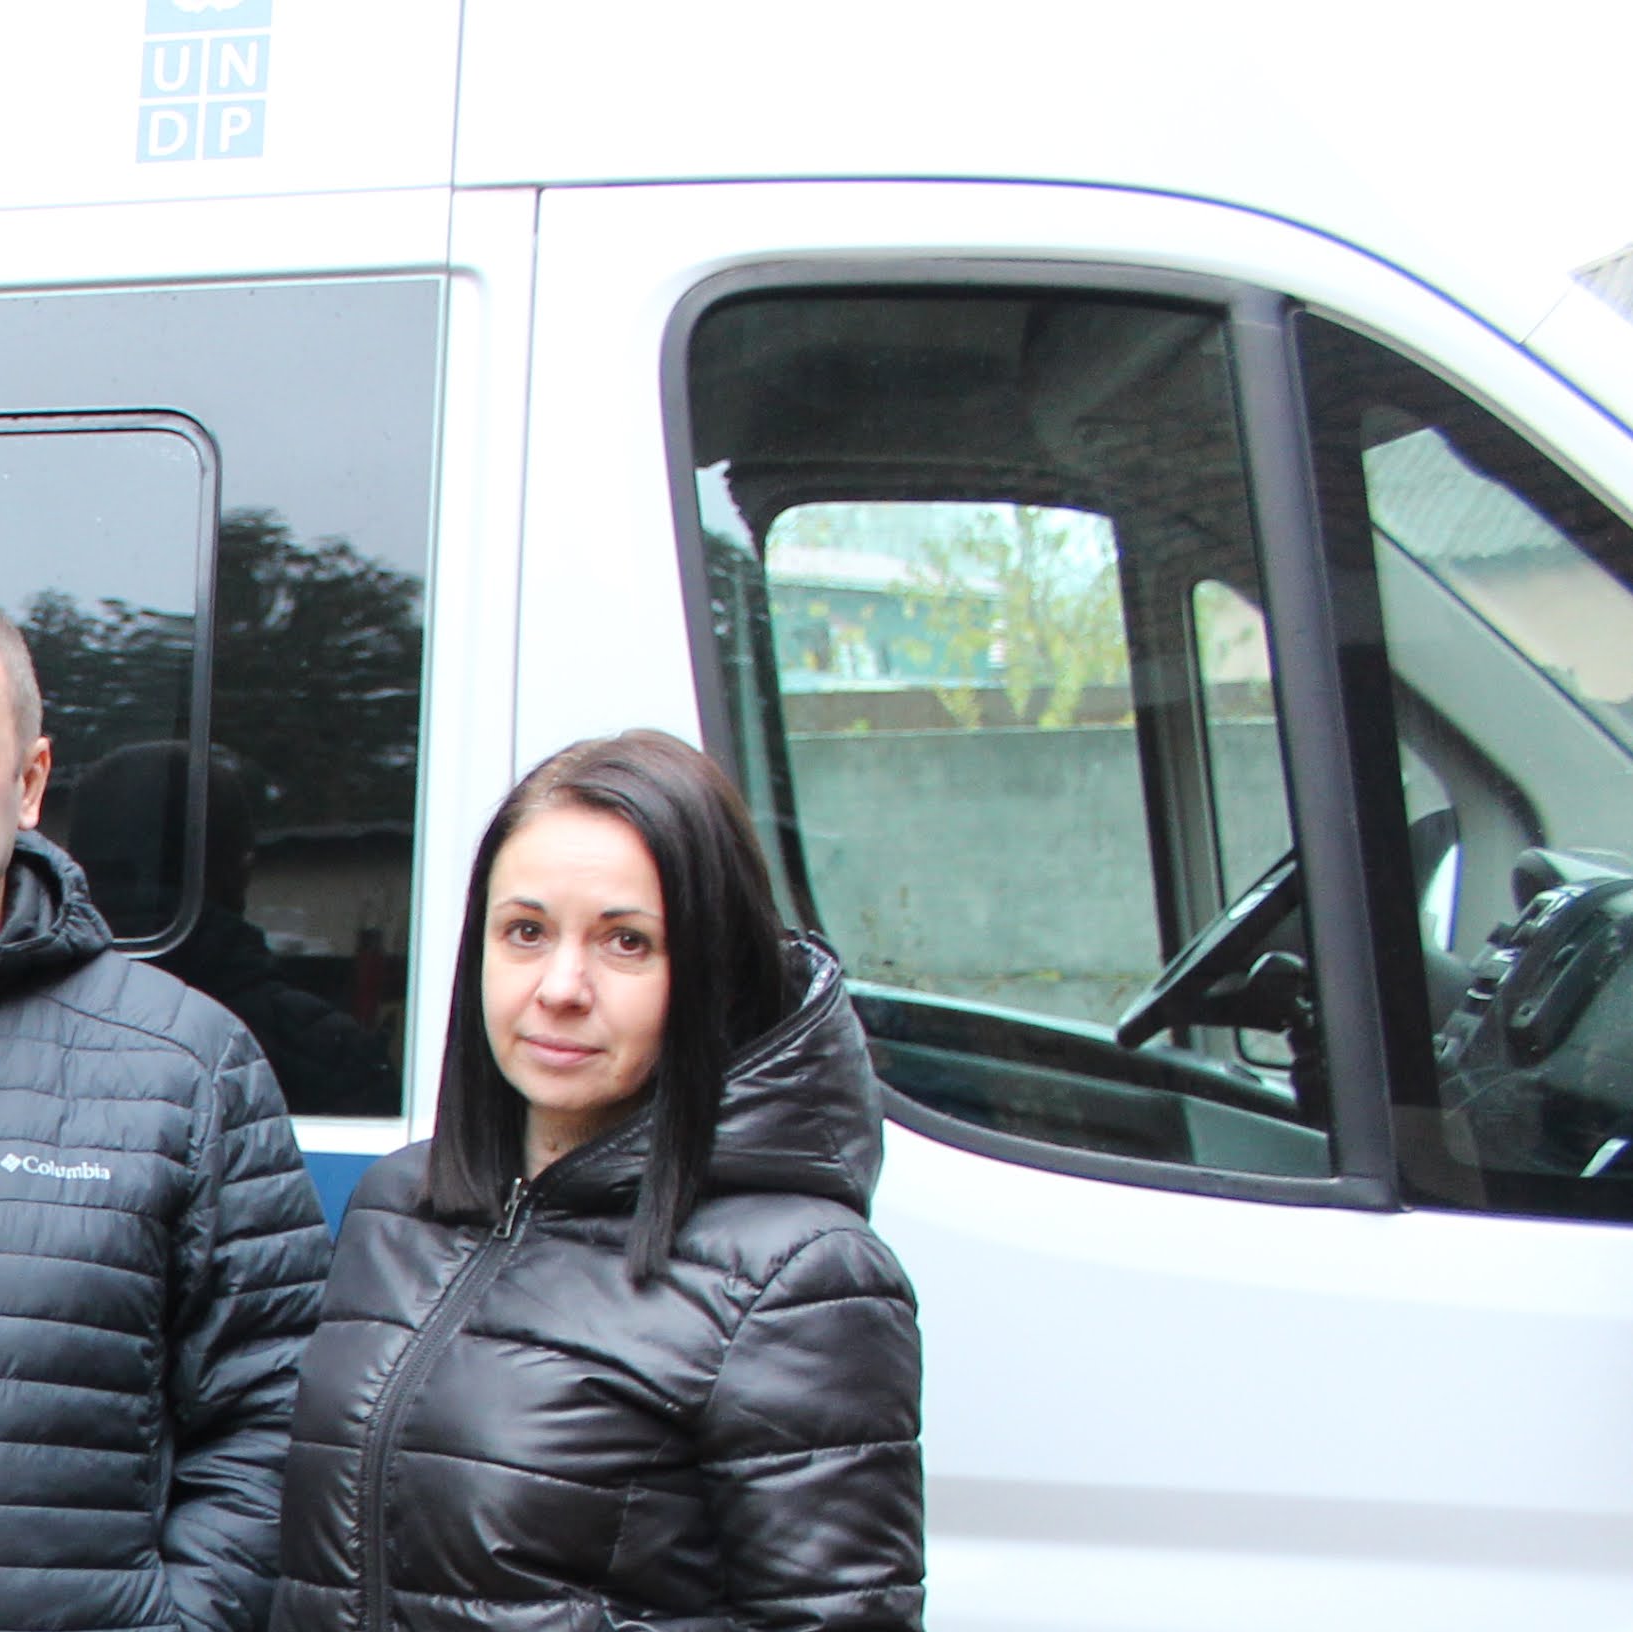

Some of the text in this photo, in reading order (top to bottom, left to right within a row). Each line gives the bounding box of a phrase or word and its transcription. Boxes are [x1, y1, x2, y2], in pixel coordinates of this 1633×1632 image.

[153, 41, 258, 92] UN
[148, 106, 252, 157] DP
[22, 1155, 110, 1180] Columbia
